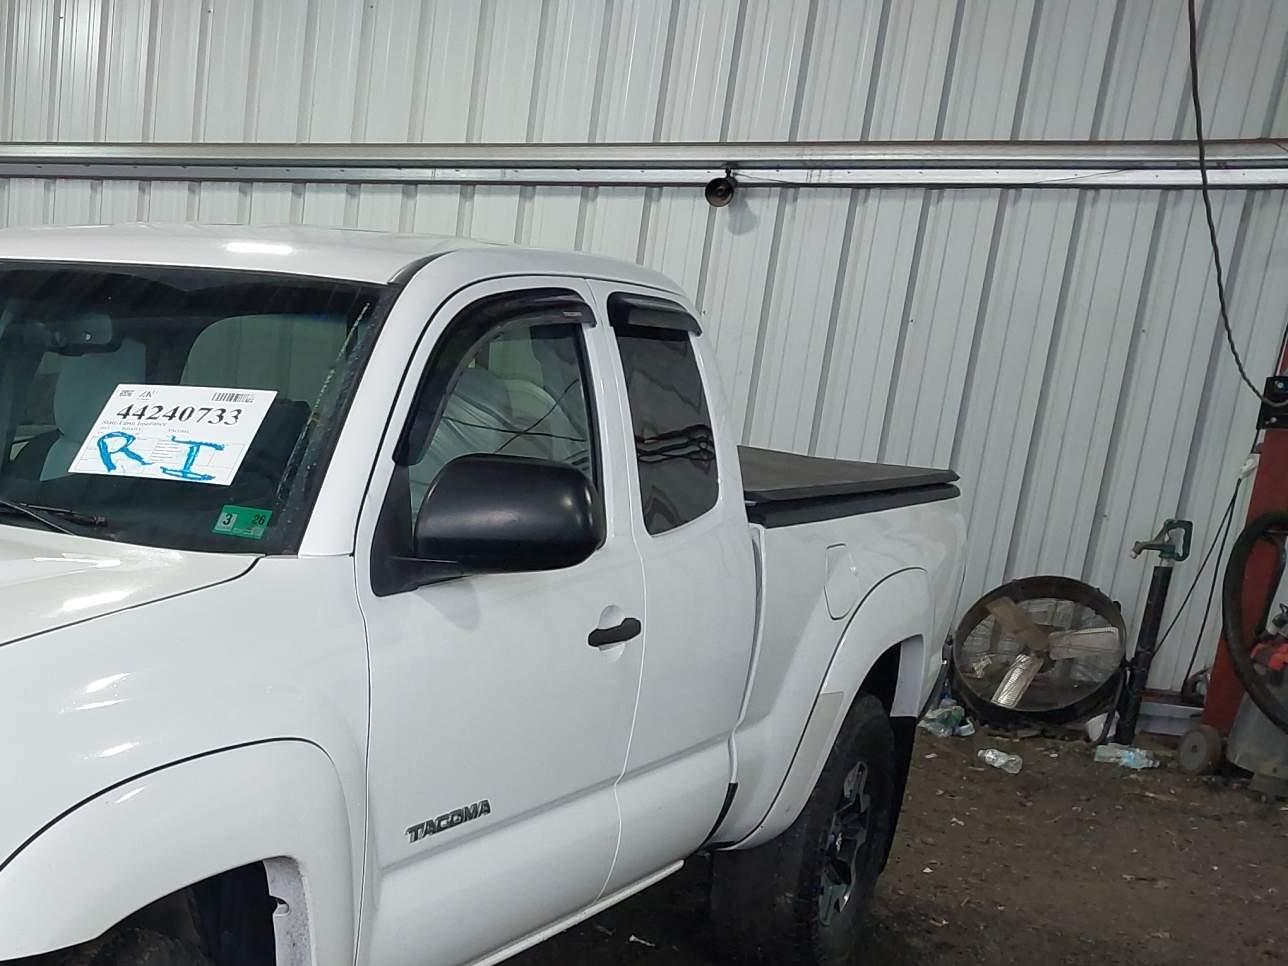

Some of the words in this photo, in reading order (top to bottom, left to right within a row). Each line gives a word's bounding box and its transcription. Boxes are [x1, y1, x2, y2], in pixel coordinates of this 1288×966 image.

[116, 403, 242, 425] 44240733
[97, 431, 154, 473] R
[160, 435, 225, 481] I
[222, 512, 233, 526] 3
[252, 514, 266, 526] 26
[404, 799, 492, 844] TACOMA
